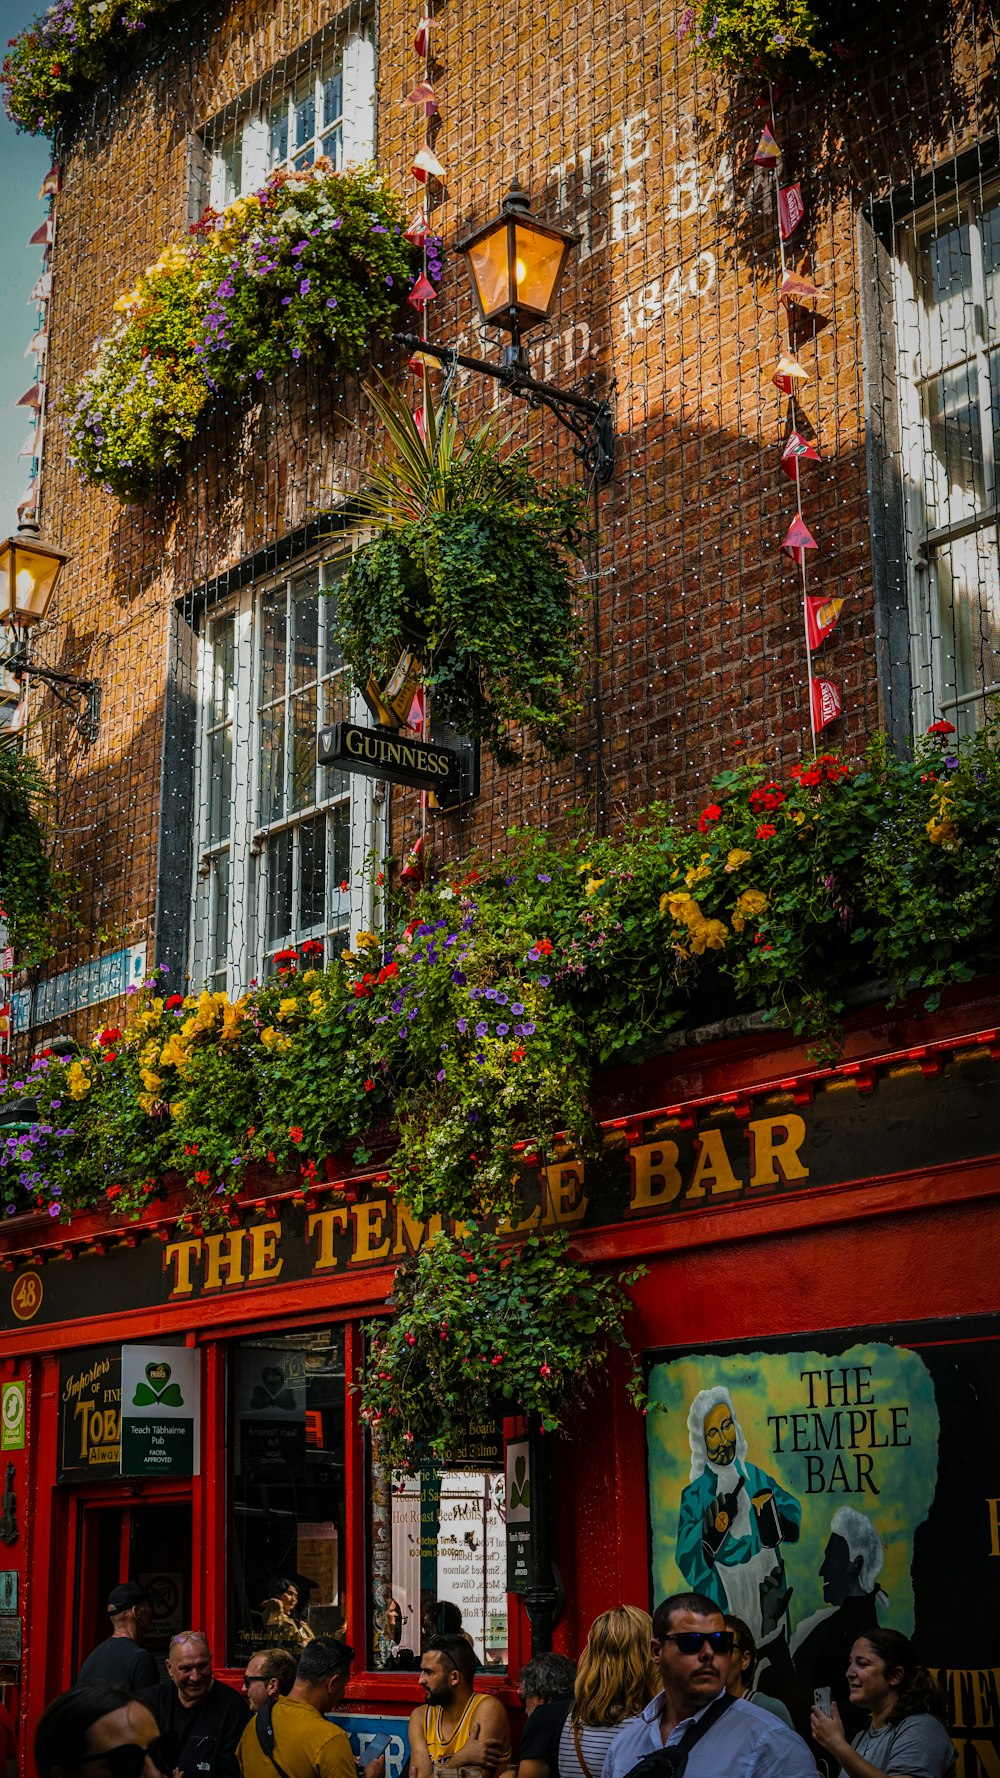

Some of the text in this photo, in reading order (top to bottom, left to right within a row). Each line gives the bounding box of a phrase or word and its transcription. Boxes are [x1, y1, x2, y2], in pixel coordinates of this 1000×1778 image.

[618, 251, 716, 340] 1840
[345, 729, 450, 776] GUINNESS
[134, 956, 143, 978] 2
[164, 1113, 810, 1297] THE TEMLE BAR
[16, 1280, 36, 1308] 48
[62, 1358, 110, 1402] Importers
[90, 1382, 101, 1394] OF
[800, 1366, 875, 1409] THE
[130, 1425, 151, 1434] Teach
[151, 1436, 165, 1445] Pub
[767, 1407, 912, 1453] TEMPLE
[804, 1453, 880, 1495] BAR
[392, 1510, 408, 1523] Hot
[410, 1510, 434, 1523] Roast
